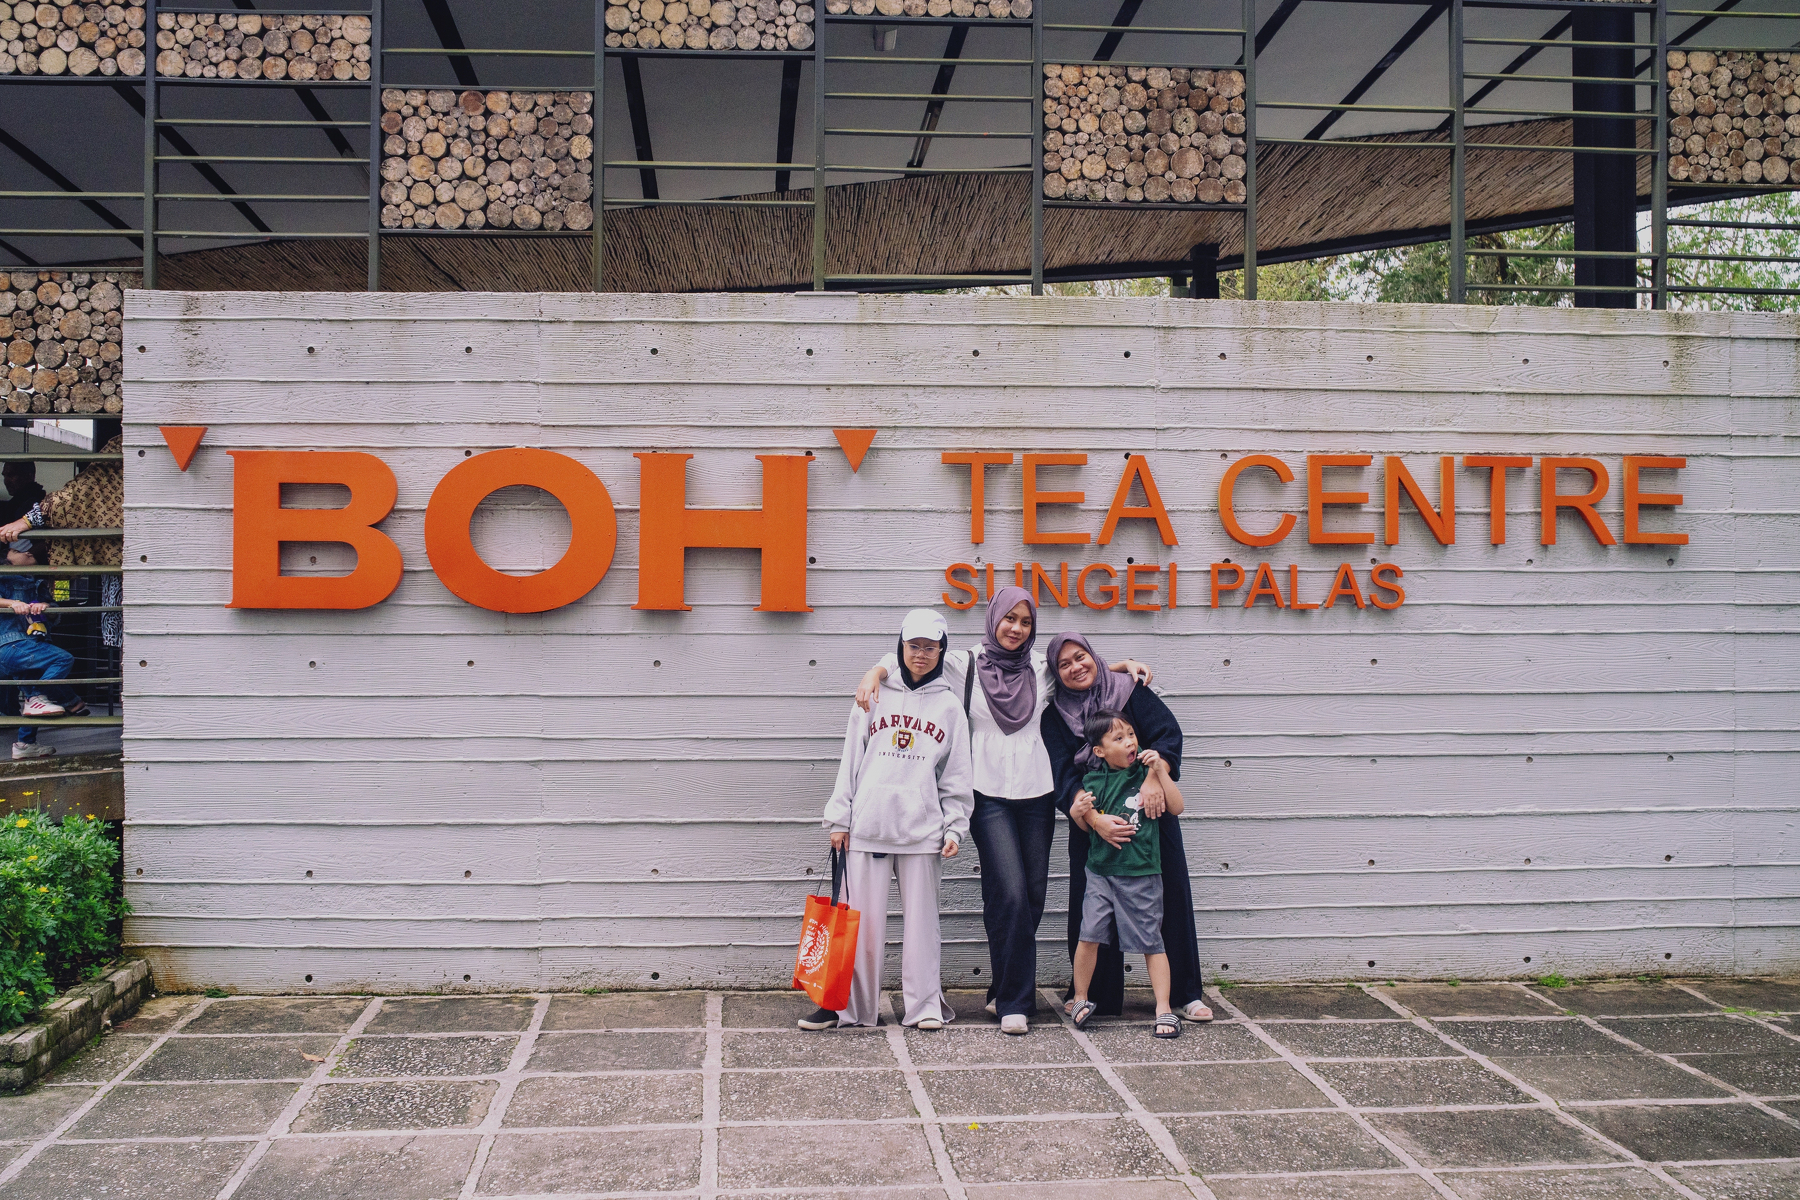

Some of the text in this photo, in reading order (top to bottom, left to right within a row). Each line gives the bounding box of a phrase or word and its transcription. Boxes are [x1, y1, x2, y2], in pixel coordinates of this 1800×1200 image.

[225, 447, 816, 614] BOH
[941, 451, 1690, 547] TEA CENTRE
[942, 561, 1406, 612] SUNGEI PALAS
[869, 714, 945, 743] HARVARD
